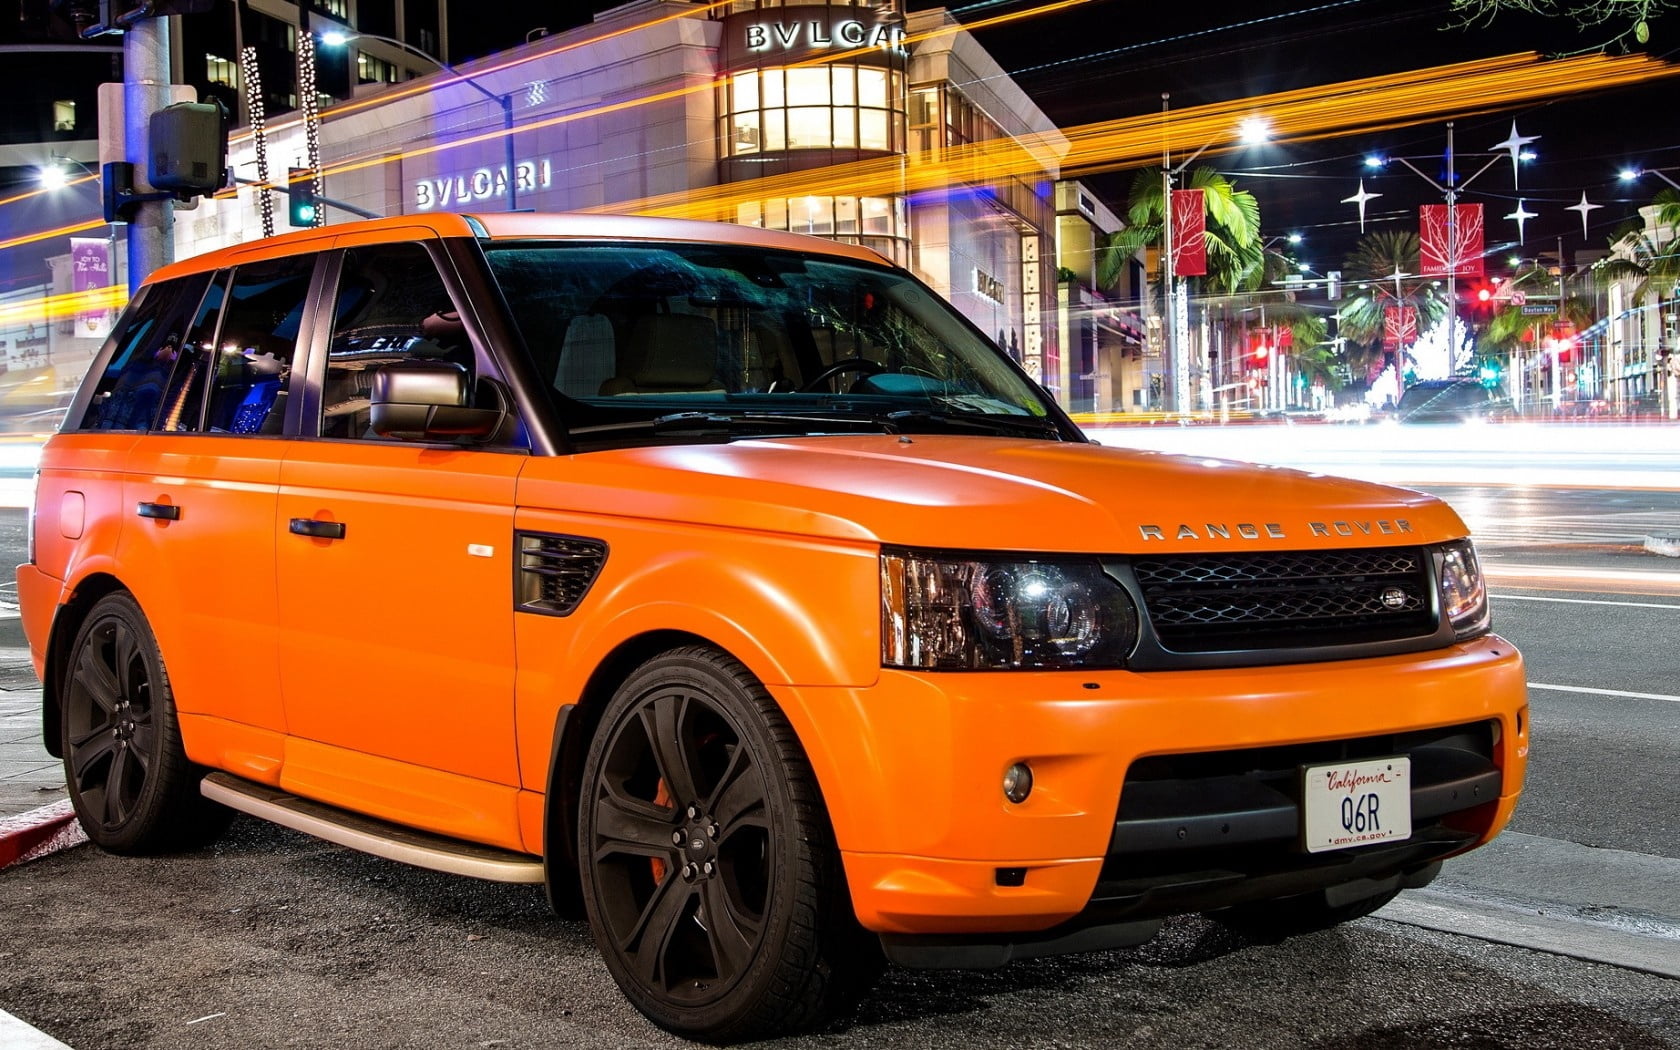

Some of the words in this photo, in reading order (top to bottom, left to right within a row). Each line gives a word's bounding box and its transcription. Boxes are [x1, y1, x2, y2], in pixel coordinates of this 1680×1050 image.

[416, 160, 552, 209] BVLGARI
[1462, 265, 1475, 273] JOY
[1138, 523, 1286, 541] RANGE
[1307, 519, 1414, 537] ROVER
[1328, 768, 1391, 793] California
[1341, 793, 1380, 834] Q6R
[1334, 831, 1386, 845] dmv.ca.gov
